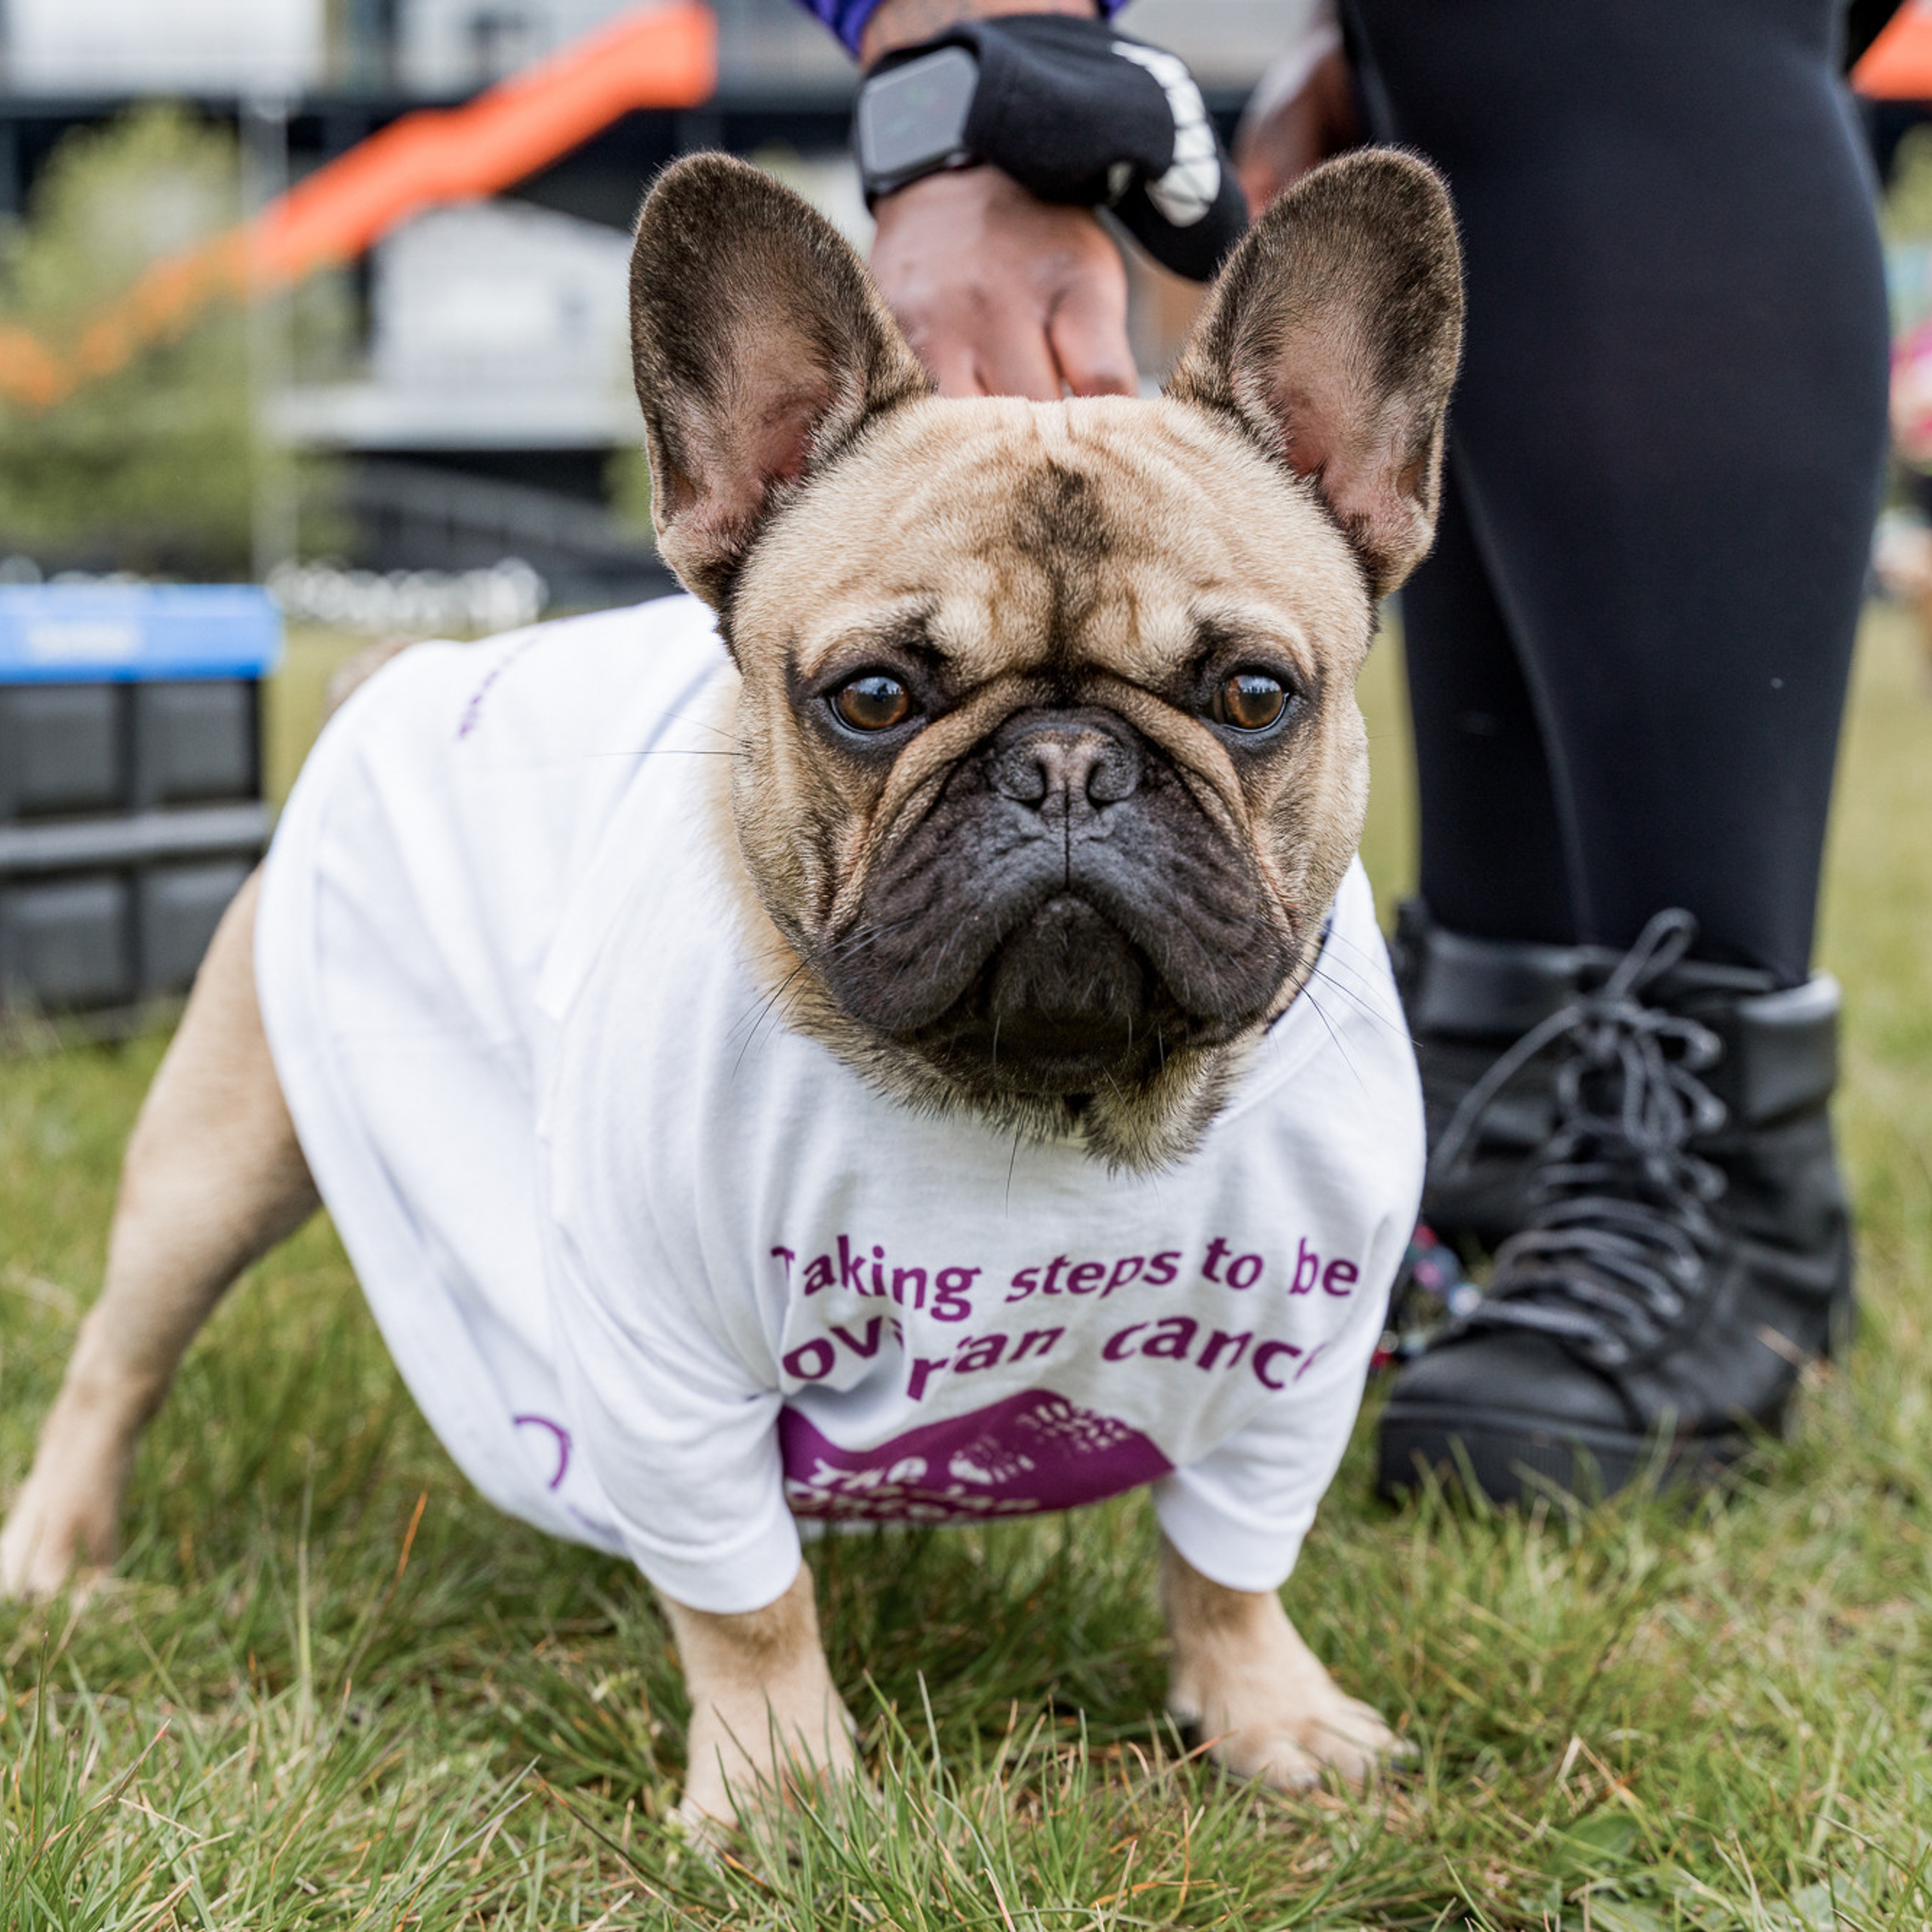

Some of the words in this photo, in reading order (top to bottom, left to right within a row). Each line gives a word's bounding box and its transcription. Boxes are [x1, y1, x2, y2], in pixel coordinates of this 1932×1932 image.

[1004, 1251, 1182, 1303] steps
[1201, 1237, 1263, 1290] to
[1288, 1237, 1358, 1297] be
[1101, 1316, 1327, 1391] canc
